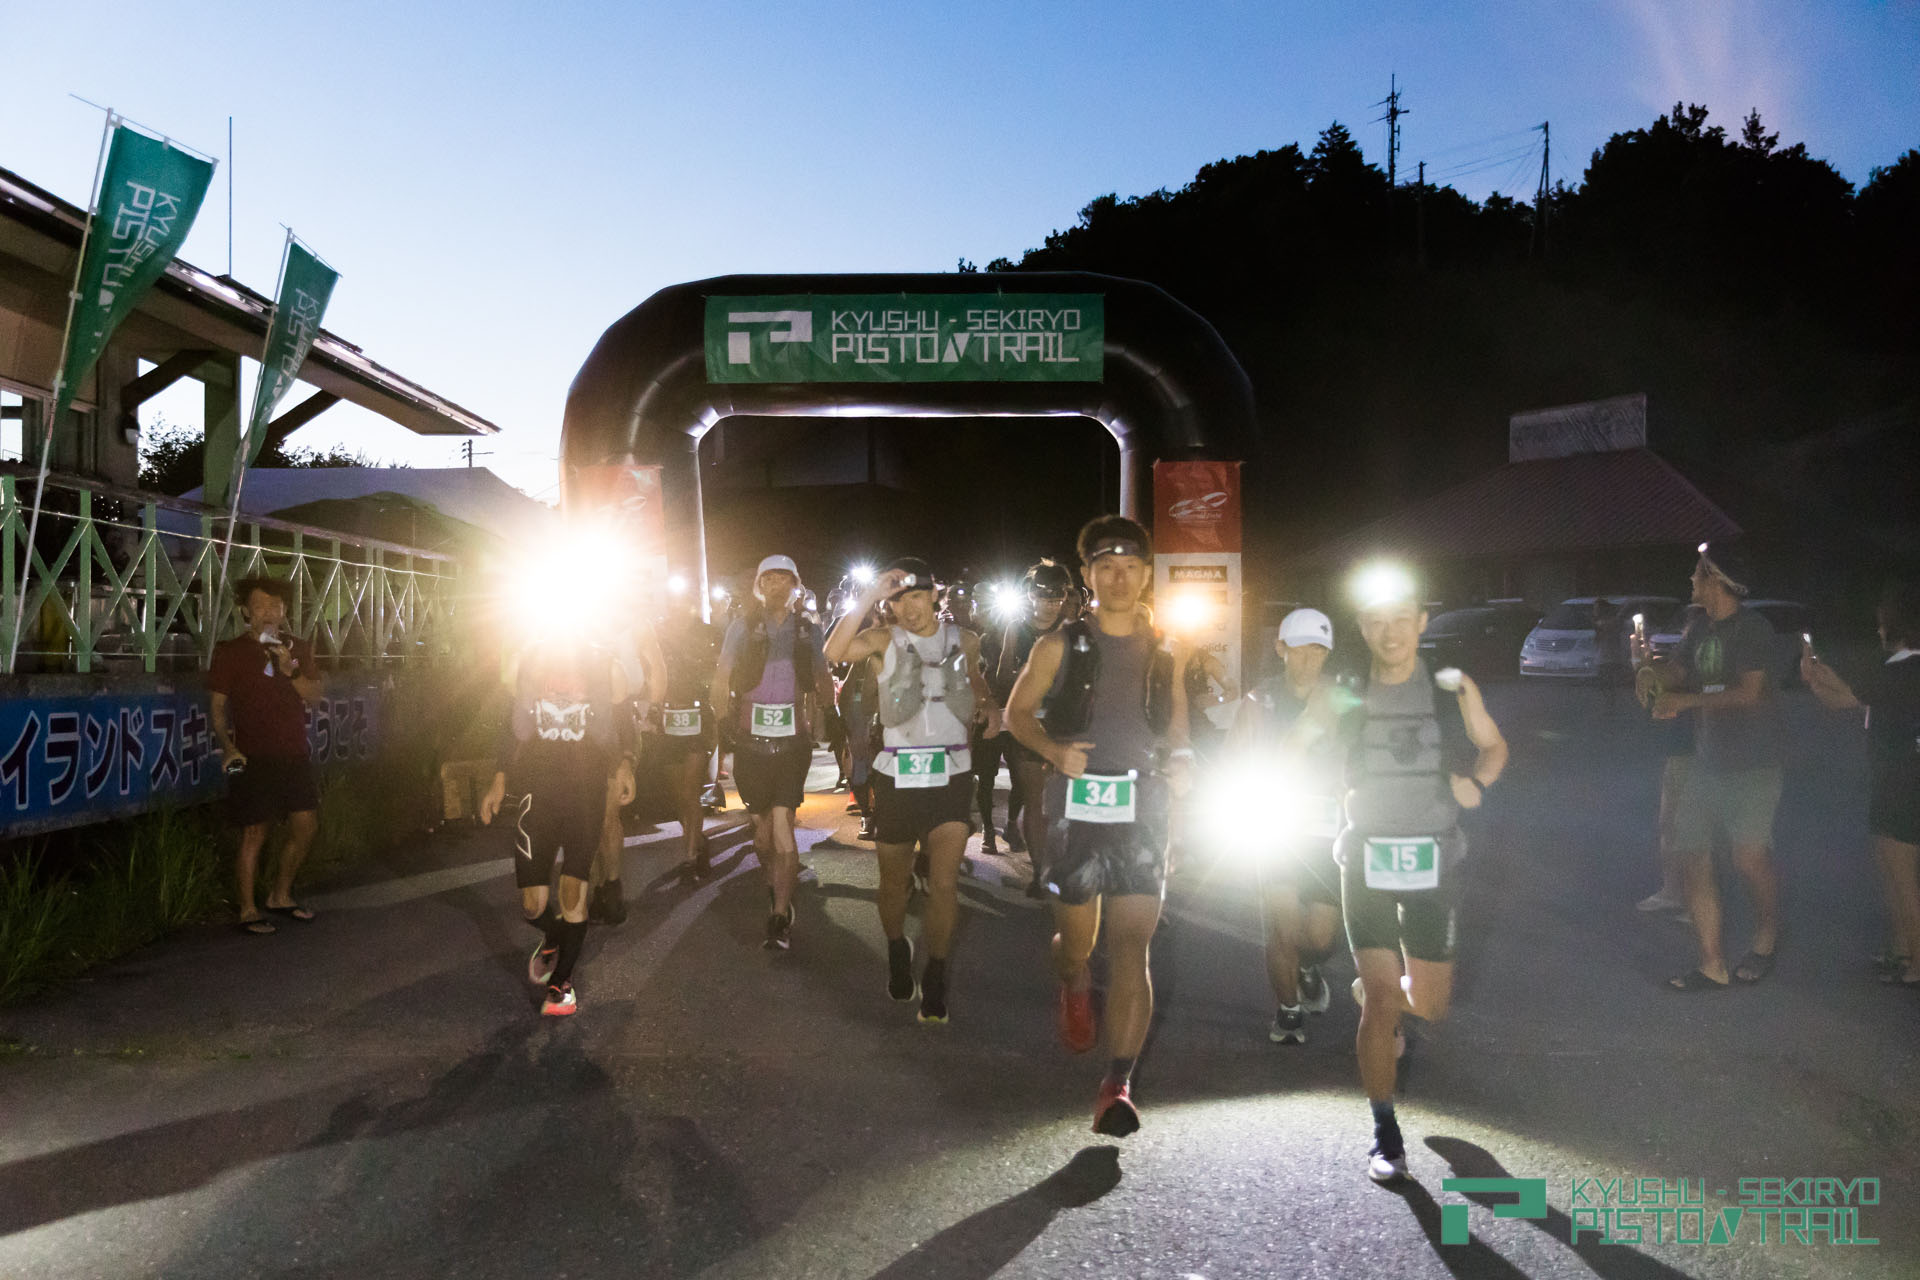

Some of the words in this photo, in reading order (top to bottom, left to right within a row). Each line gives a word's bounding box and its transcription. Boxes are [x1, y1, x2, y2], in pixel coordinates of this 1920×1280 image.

[832, 311, 938, 331] KYUSHU
[967, 309, 1080, 331] SEKIRYO
[763, 711, 784, 726] 52
[909, 754, 934, 774] 37
[1085, 782, 1118, 806] 34
[1390, 846, 1418, 872] 15
